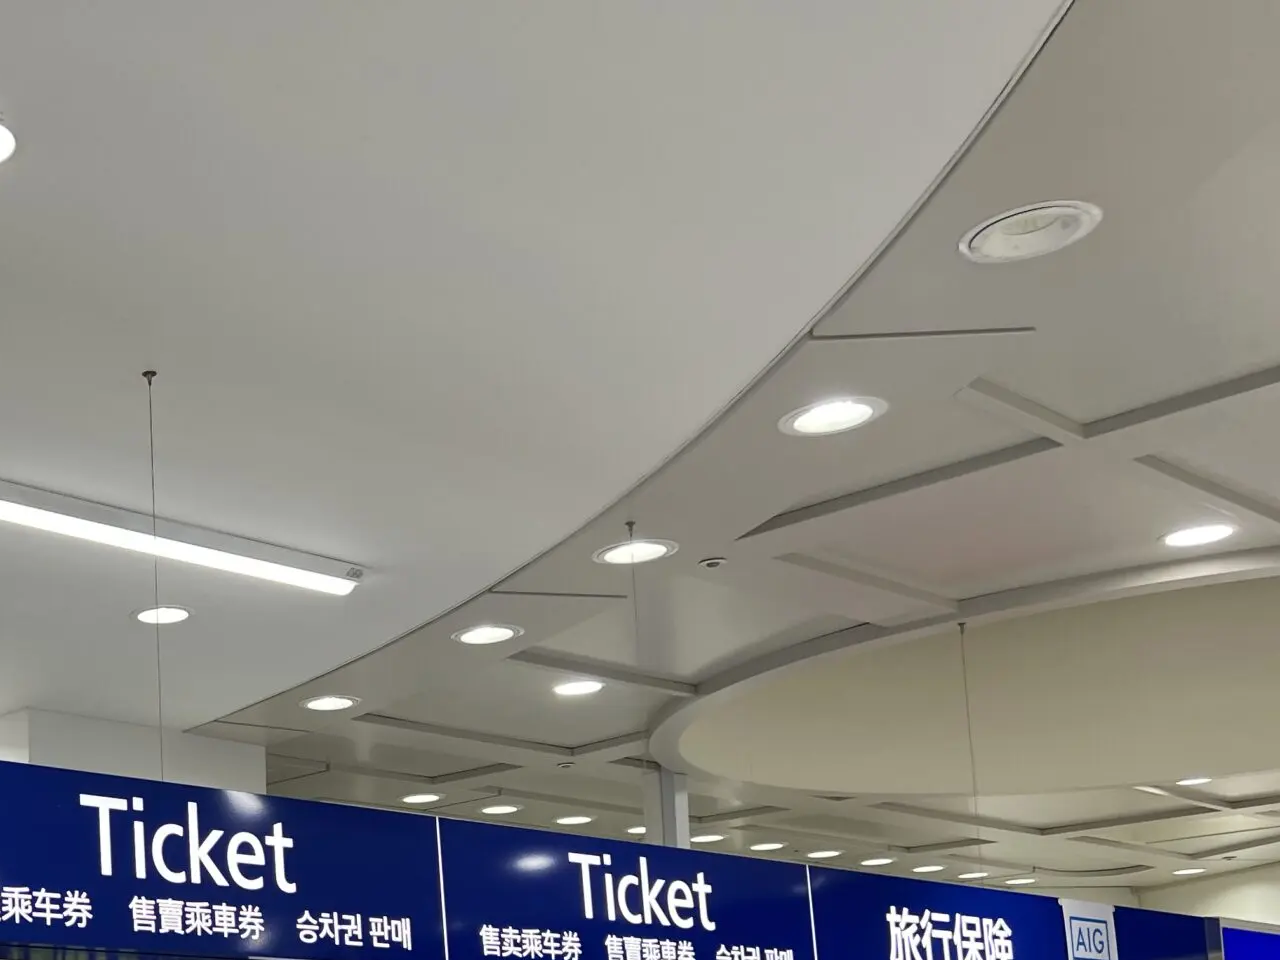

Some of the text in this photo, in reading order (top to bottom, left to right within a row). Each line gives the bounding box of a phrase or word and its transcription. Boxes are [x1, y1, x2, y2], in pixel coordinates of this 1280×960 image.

[79, 793, 297, 894] Ticket
[568, 852, 716, 932] Ticket
[129, 896, 265, 941] 售賣乘車券
[296, 912, 412, 951] 승차권 판매
[1076, 927, 1104, 954] AIG
